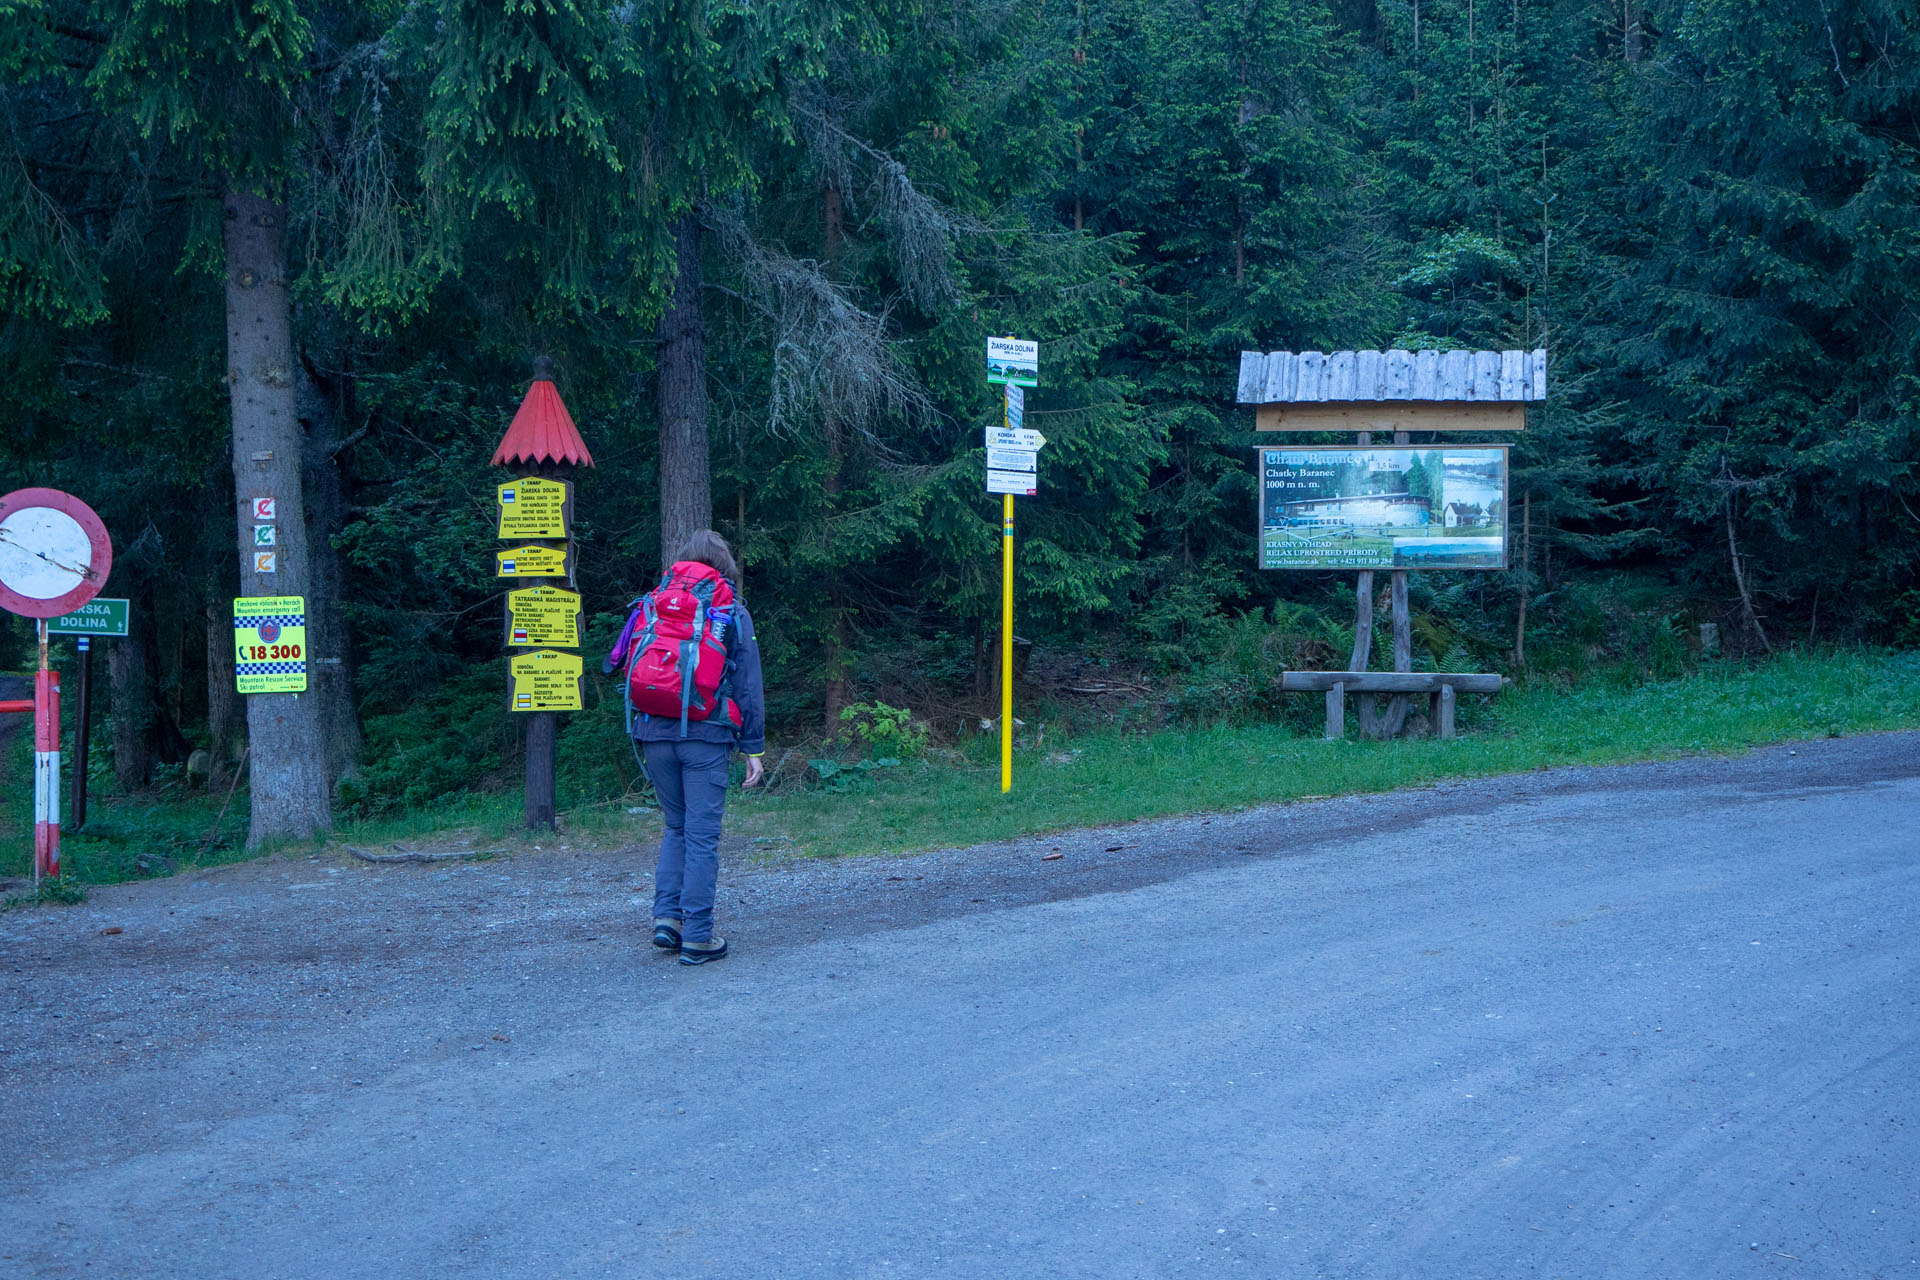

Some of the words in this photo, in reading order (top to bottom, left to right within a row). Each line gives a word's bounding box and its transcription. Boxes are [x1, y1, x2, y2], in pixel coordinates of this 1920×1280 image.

[991, 341, 1013, 350] ŽIARSKA
[1266, 470, 1297, 479] Chatky
[60, 617, 108, 628] DOLINA
[250, 646, 267, 660] 18
[270, 644, 301, 659] 300
